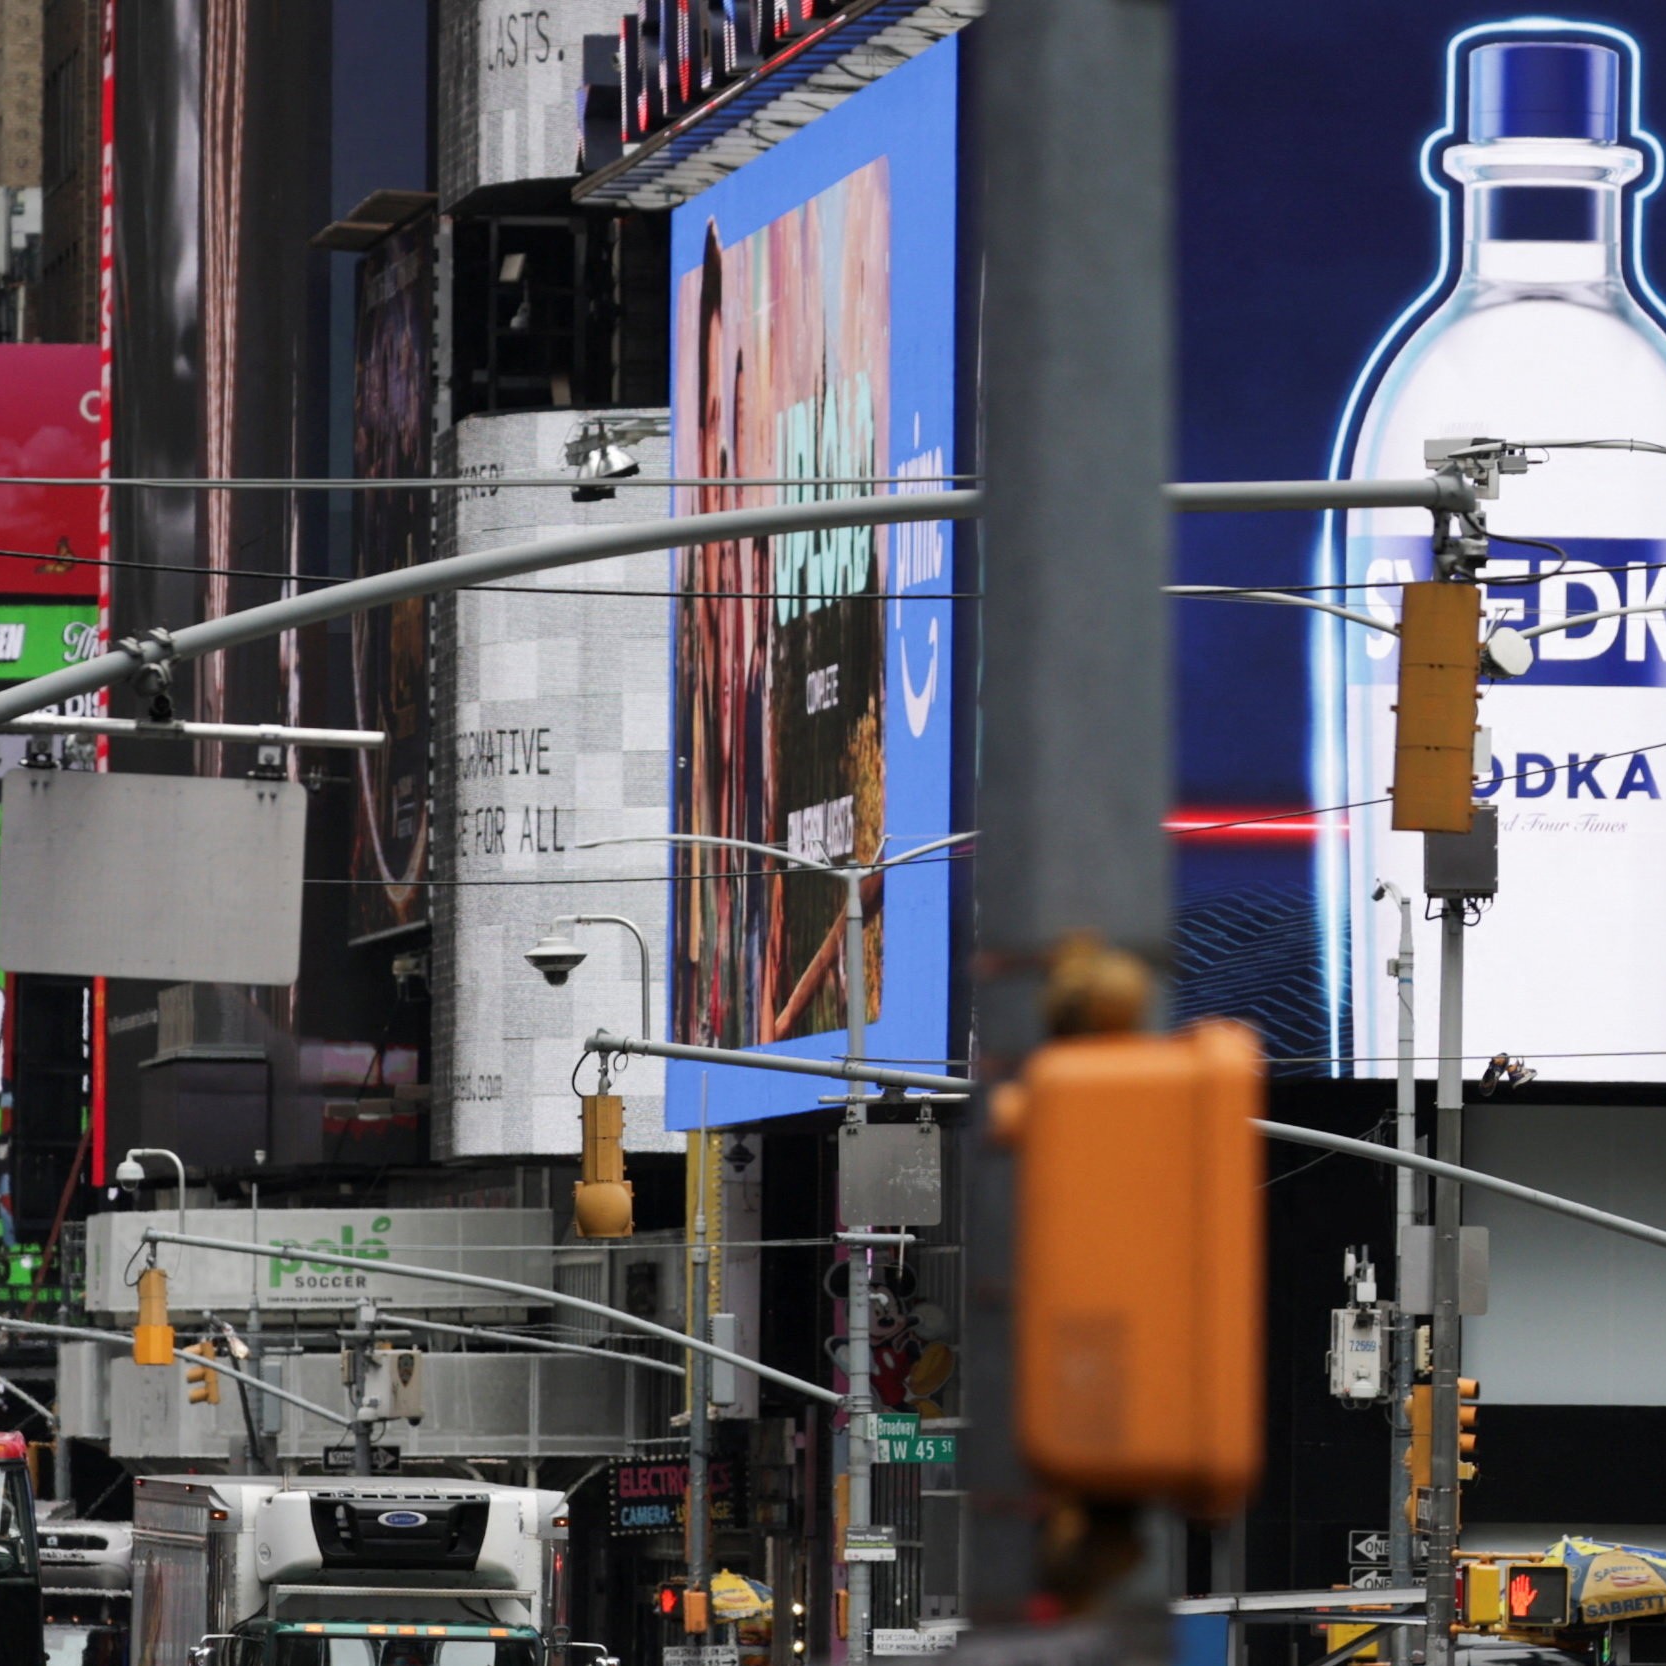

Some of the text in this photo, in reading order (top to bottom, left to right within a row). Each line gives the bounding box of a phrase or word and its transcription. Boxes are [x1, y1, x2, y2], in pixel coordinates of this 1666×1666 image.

[474, 804, 565, 856] FOR ALL
[294, 1275, 367, 1288] SOCCER
[878, 1418, 916, 1440] Broadway
[893, 1440, 952, 1460] W 45 St
[620, 1504, 670, 1527] CAMERA
[1365, 1540, 1390, 1556] ONE
